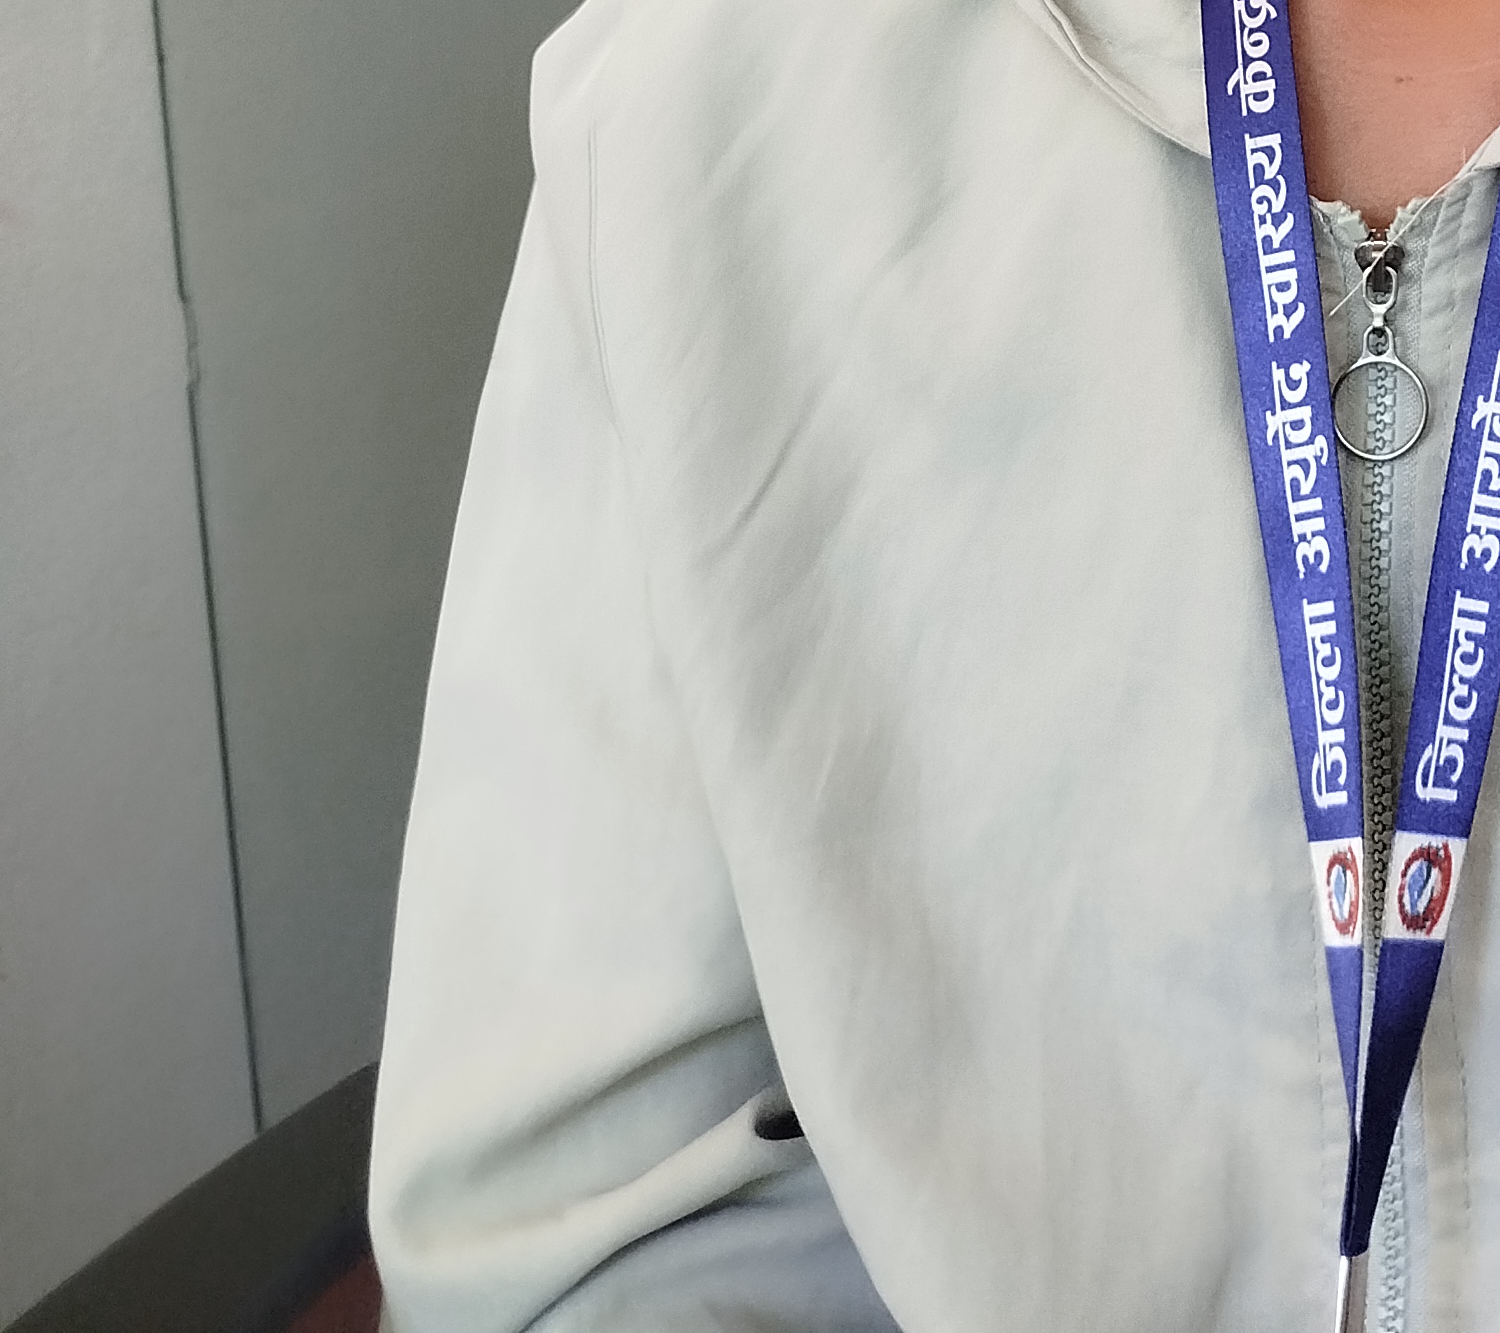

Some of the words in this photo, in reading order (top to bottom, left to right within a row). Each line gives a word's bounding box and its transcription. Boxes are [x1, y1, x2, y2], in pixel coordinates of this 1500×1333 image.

[1244, 132, 1305, 343] स्वास्थ्य
[1266, 359, 1331, 579] आयुर्वेद
[1302, 598, 1349, 810] जिल्ला
[1415, 590, 1490, 804] जिल्ला
